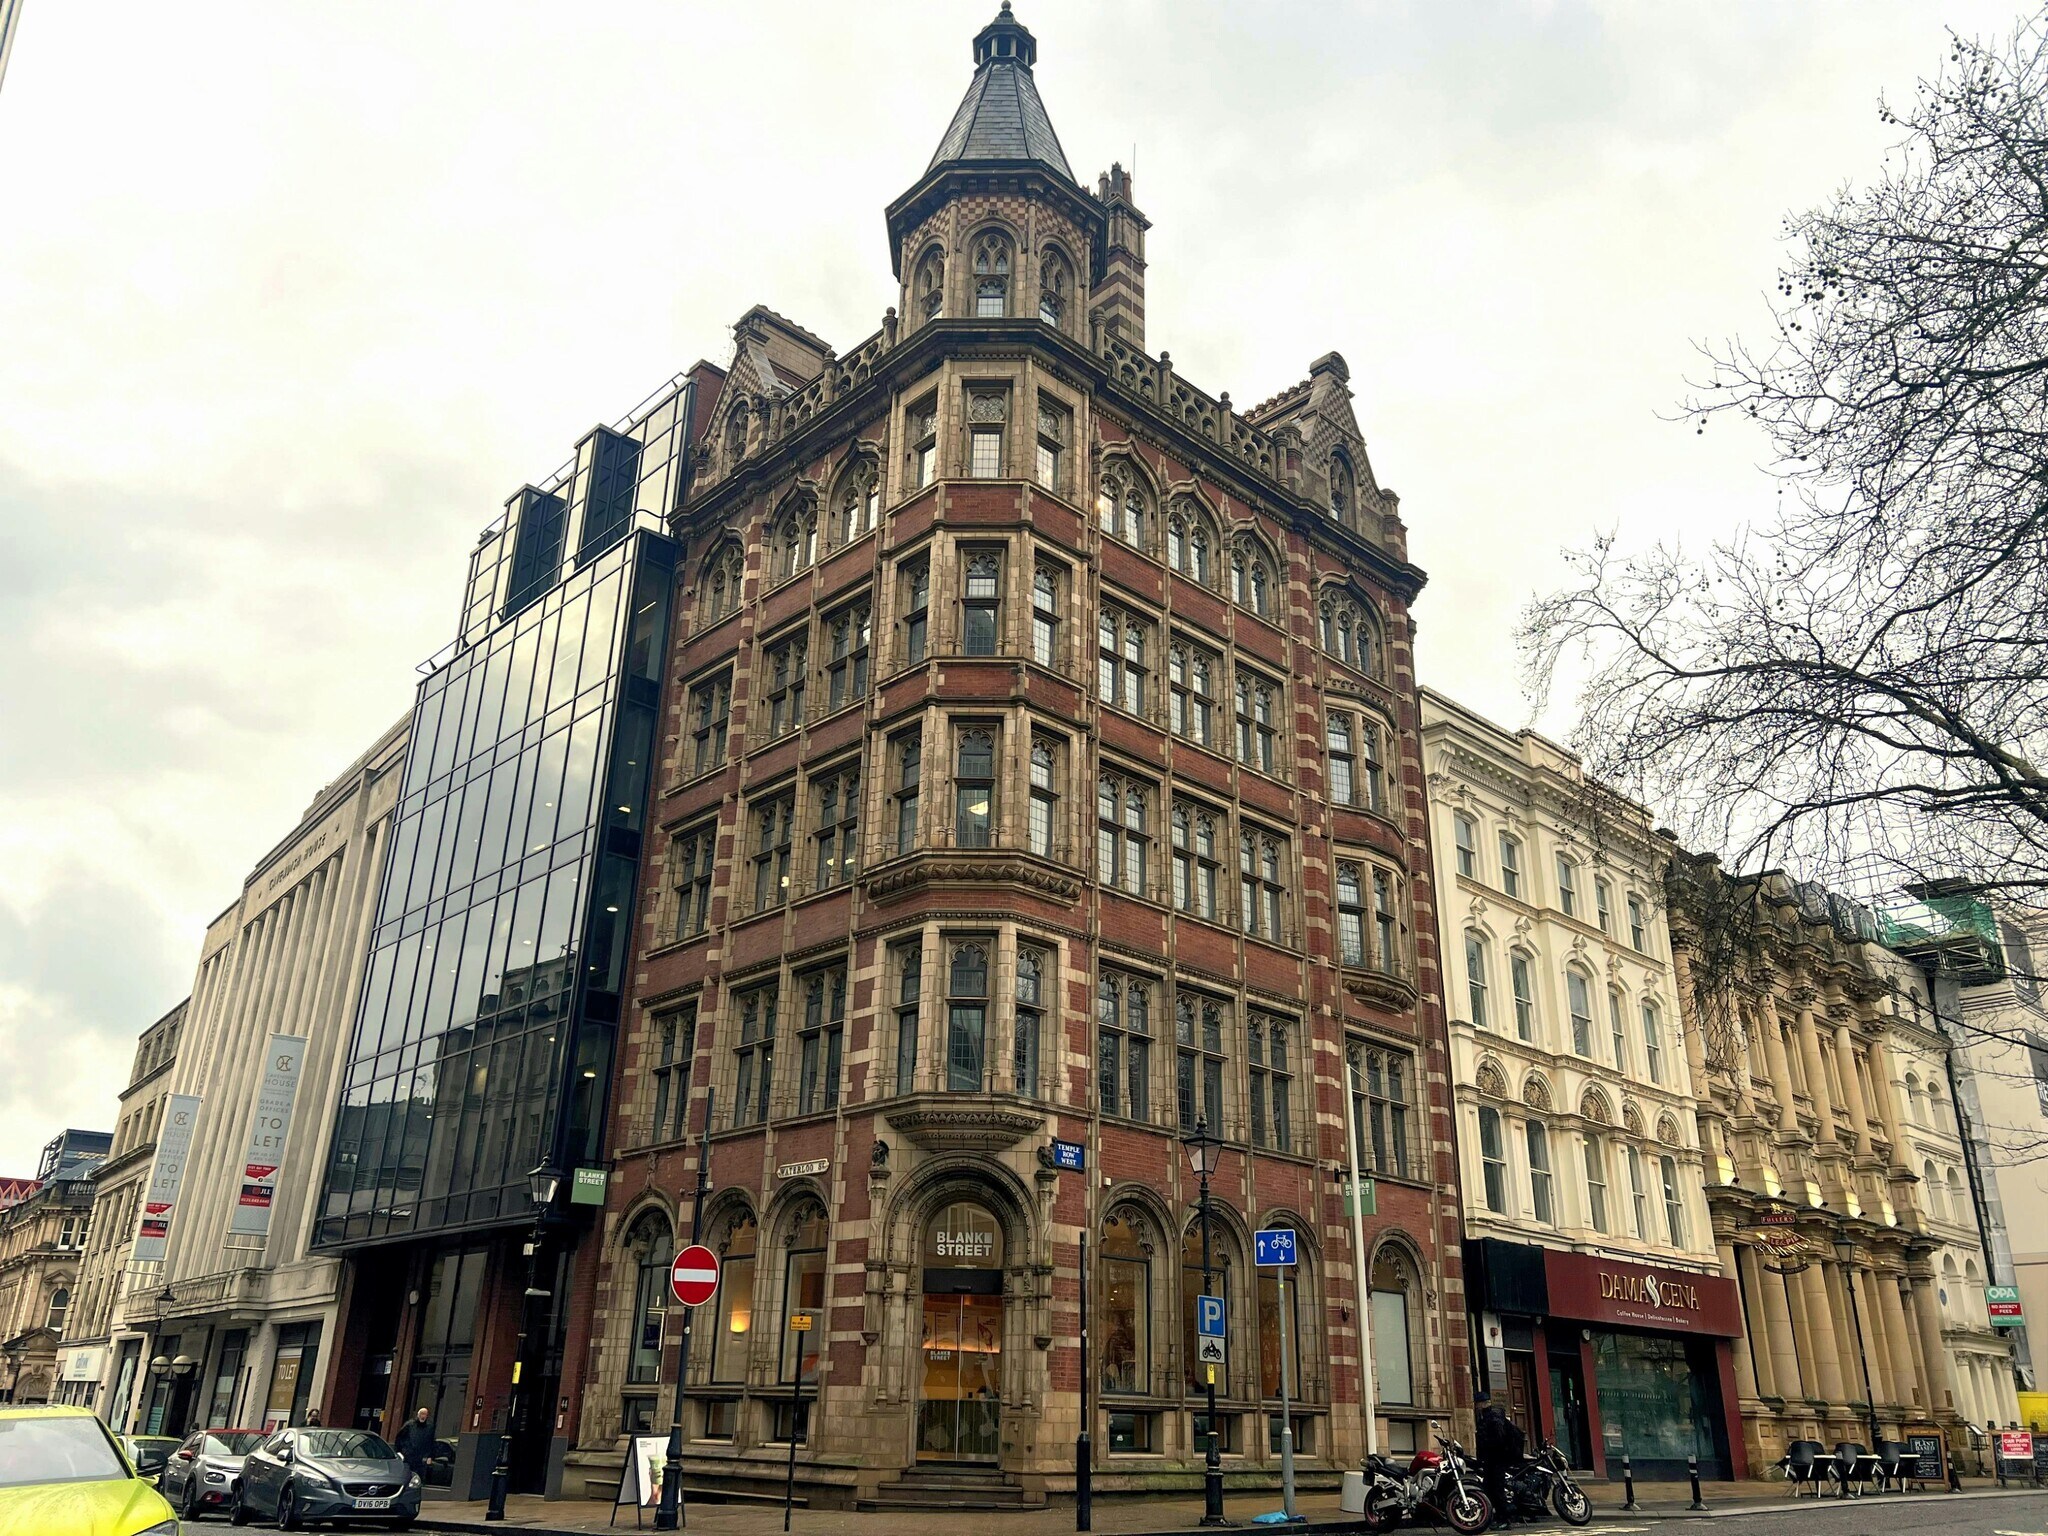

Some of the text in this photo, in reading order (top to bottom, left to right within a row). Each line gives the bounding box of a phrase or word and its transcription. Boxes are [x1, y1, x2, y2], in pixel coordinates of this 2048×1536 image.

[265, 1078, 296, 1088] HOUSE
[260, 1105, 289, 1114] OFFICES
[260, 1116, 282, 1130] TO
[253, 1134, 282, 1149] LET
[1057, 1143, 1080, 1154] TEMPLE
[1062, 1150, 1076, 1159] ROW
[1060, 1157, 1077, 1166] WEST
[159, 1163, 178, 1175] TO
[778, 1163, 814, 1176] WATERLOO
[152, 1177, 177, 1190] LET
[578, 1177, 604, 1186] STREET
[936, 1231, 983, 1244] BLANK
[936, 1244, 993, 1257] STREET
[1599, 1272, 1700, 1309] DAMASCENA
[1204, 1300, 1221, 1332] P
[1616, 1309, 1631, 1318] Coffee
[278, 1364, 297, 1380] TO LET
[476, 1397, 483, 1407] 42
[561, 1399, 568, 1409] 44
